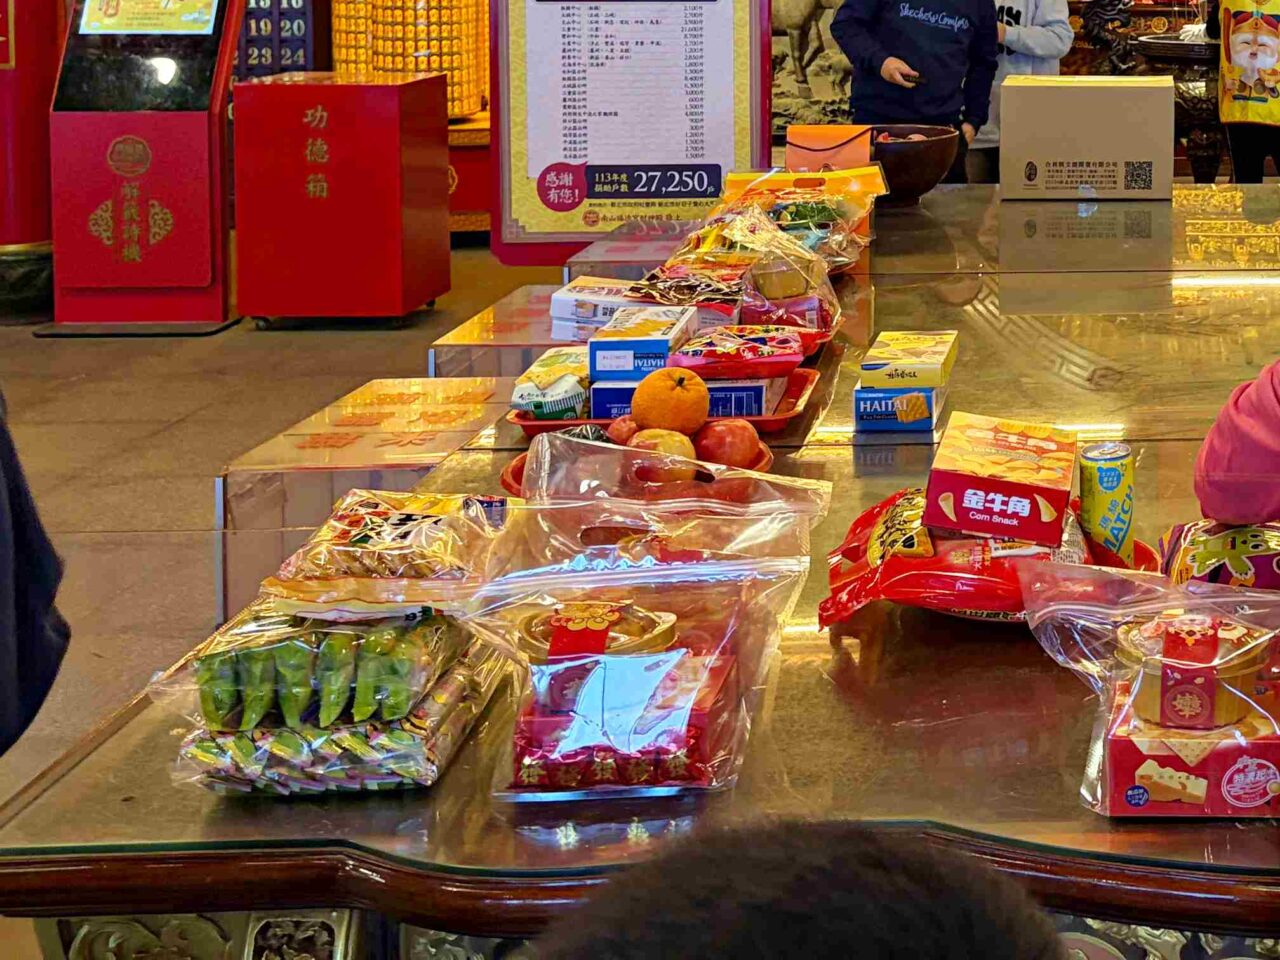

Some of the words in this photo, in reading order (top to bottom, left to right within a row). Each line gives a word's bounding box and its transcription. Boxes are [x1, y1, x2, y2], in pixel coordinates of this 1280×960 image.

[249, 19, 272, 36] 19
[280, 19, 306, 37] 20
[247, 47, 273, 65] 23
[280, 48, 306, 65] 24
[303, 105, 330, 200] 功德箱
[545, 171, 574, 187] 感謝
[633, 171, 708, 194] 27,250
[859, 399, 908, 413] HAITAI
[961, 488, 1032, 518] 金牛角
[968, 511, 991, 522] Corn
[991, 514, 1020, 527] Snack
